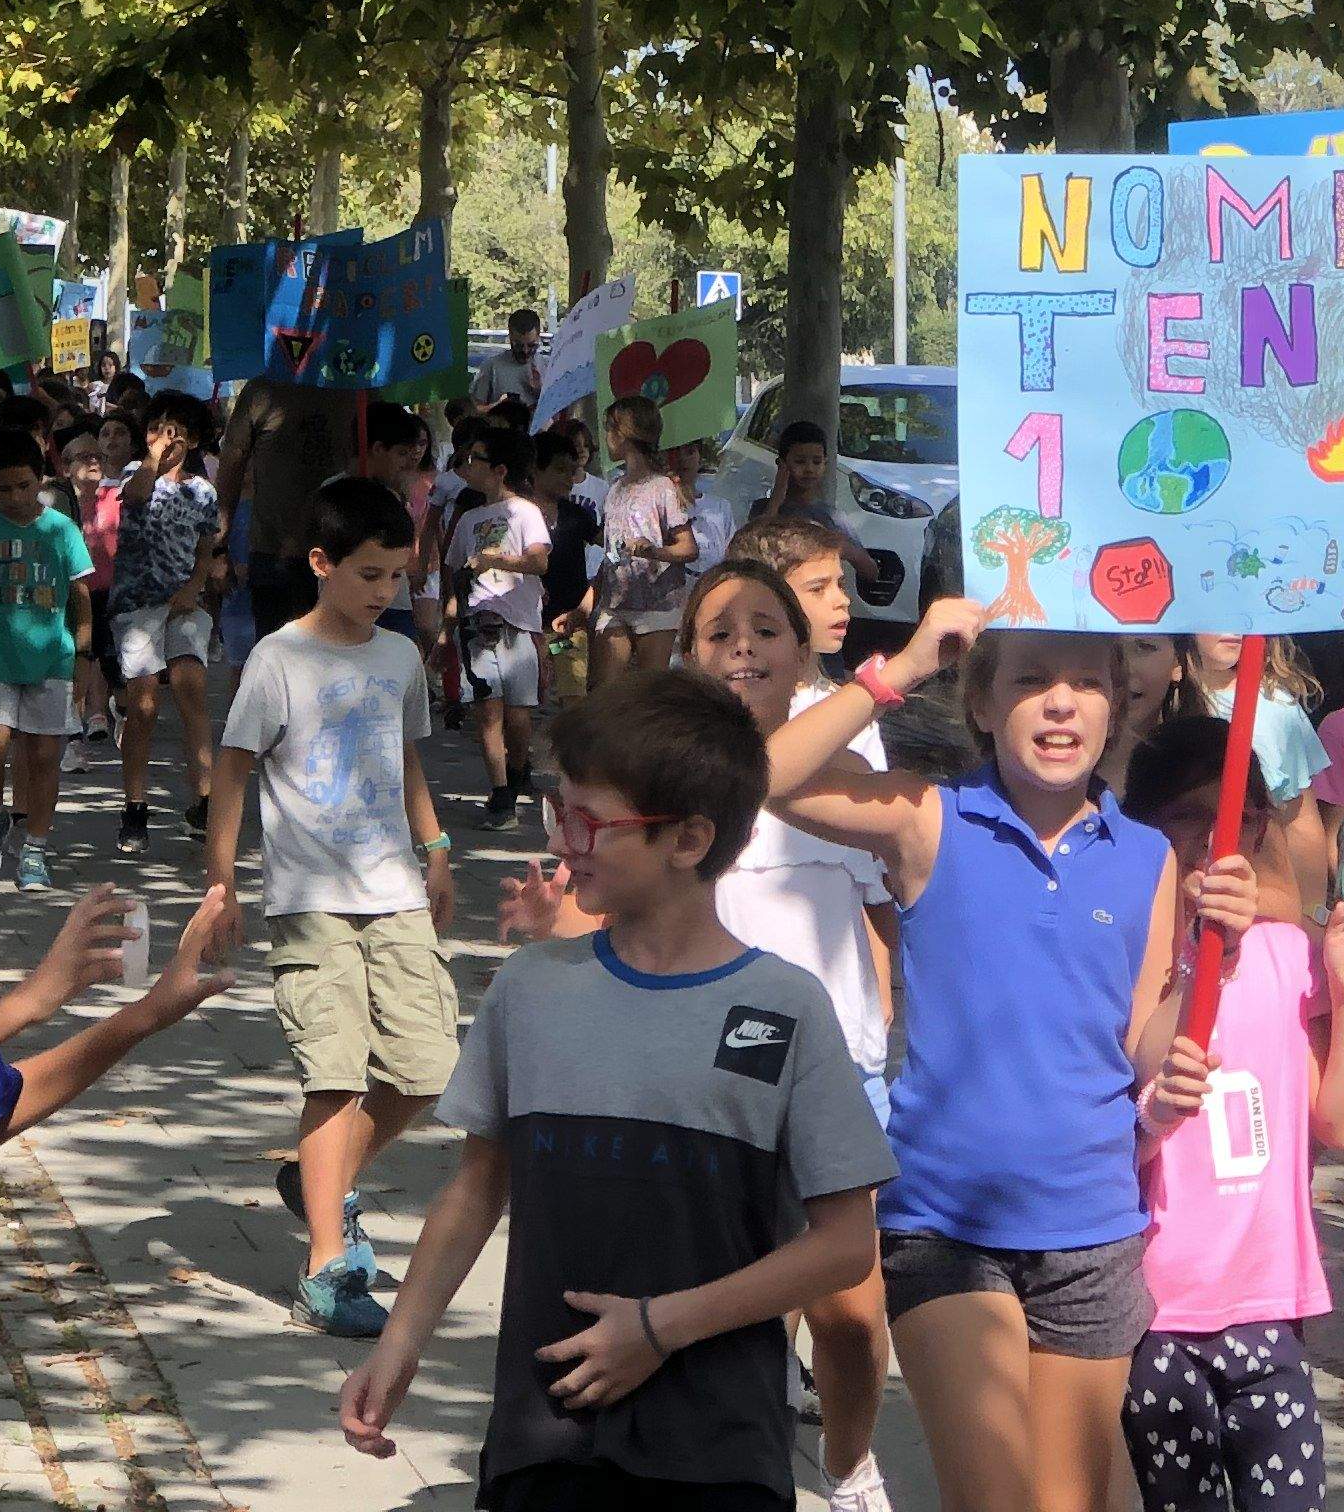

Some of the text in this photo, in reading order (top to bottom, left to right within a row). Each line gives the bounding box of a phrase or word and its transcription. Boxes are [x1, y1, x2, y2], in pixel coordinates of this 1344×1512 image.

[1003, 412, 1064, 519] 1
[737, 1019, 778, 1040] NIKE
[532, 1128, 623, 1161] NIKE
[1250, 1087, 1267, 1158] SAN DIEGO
